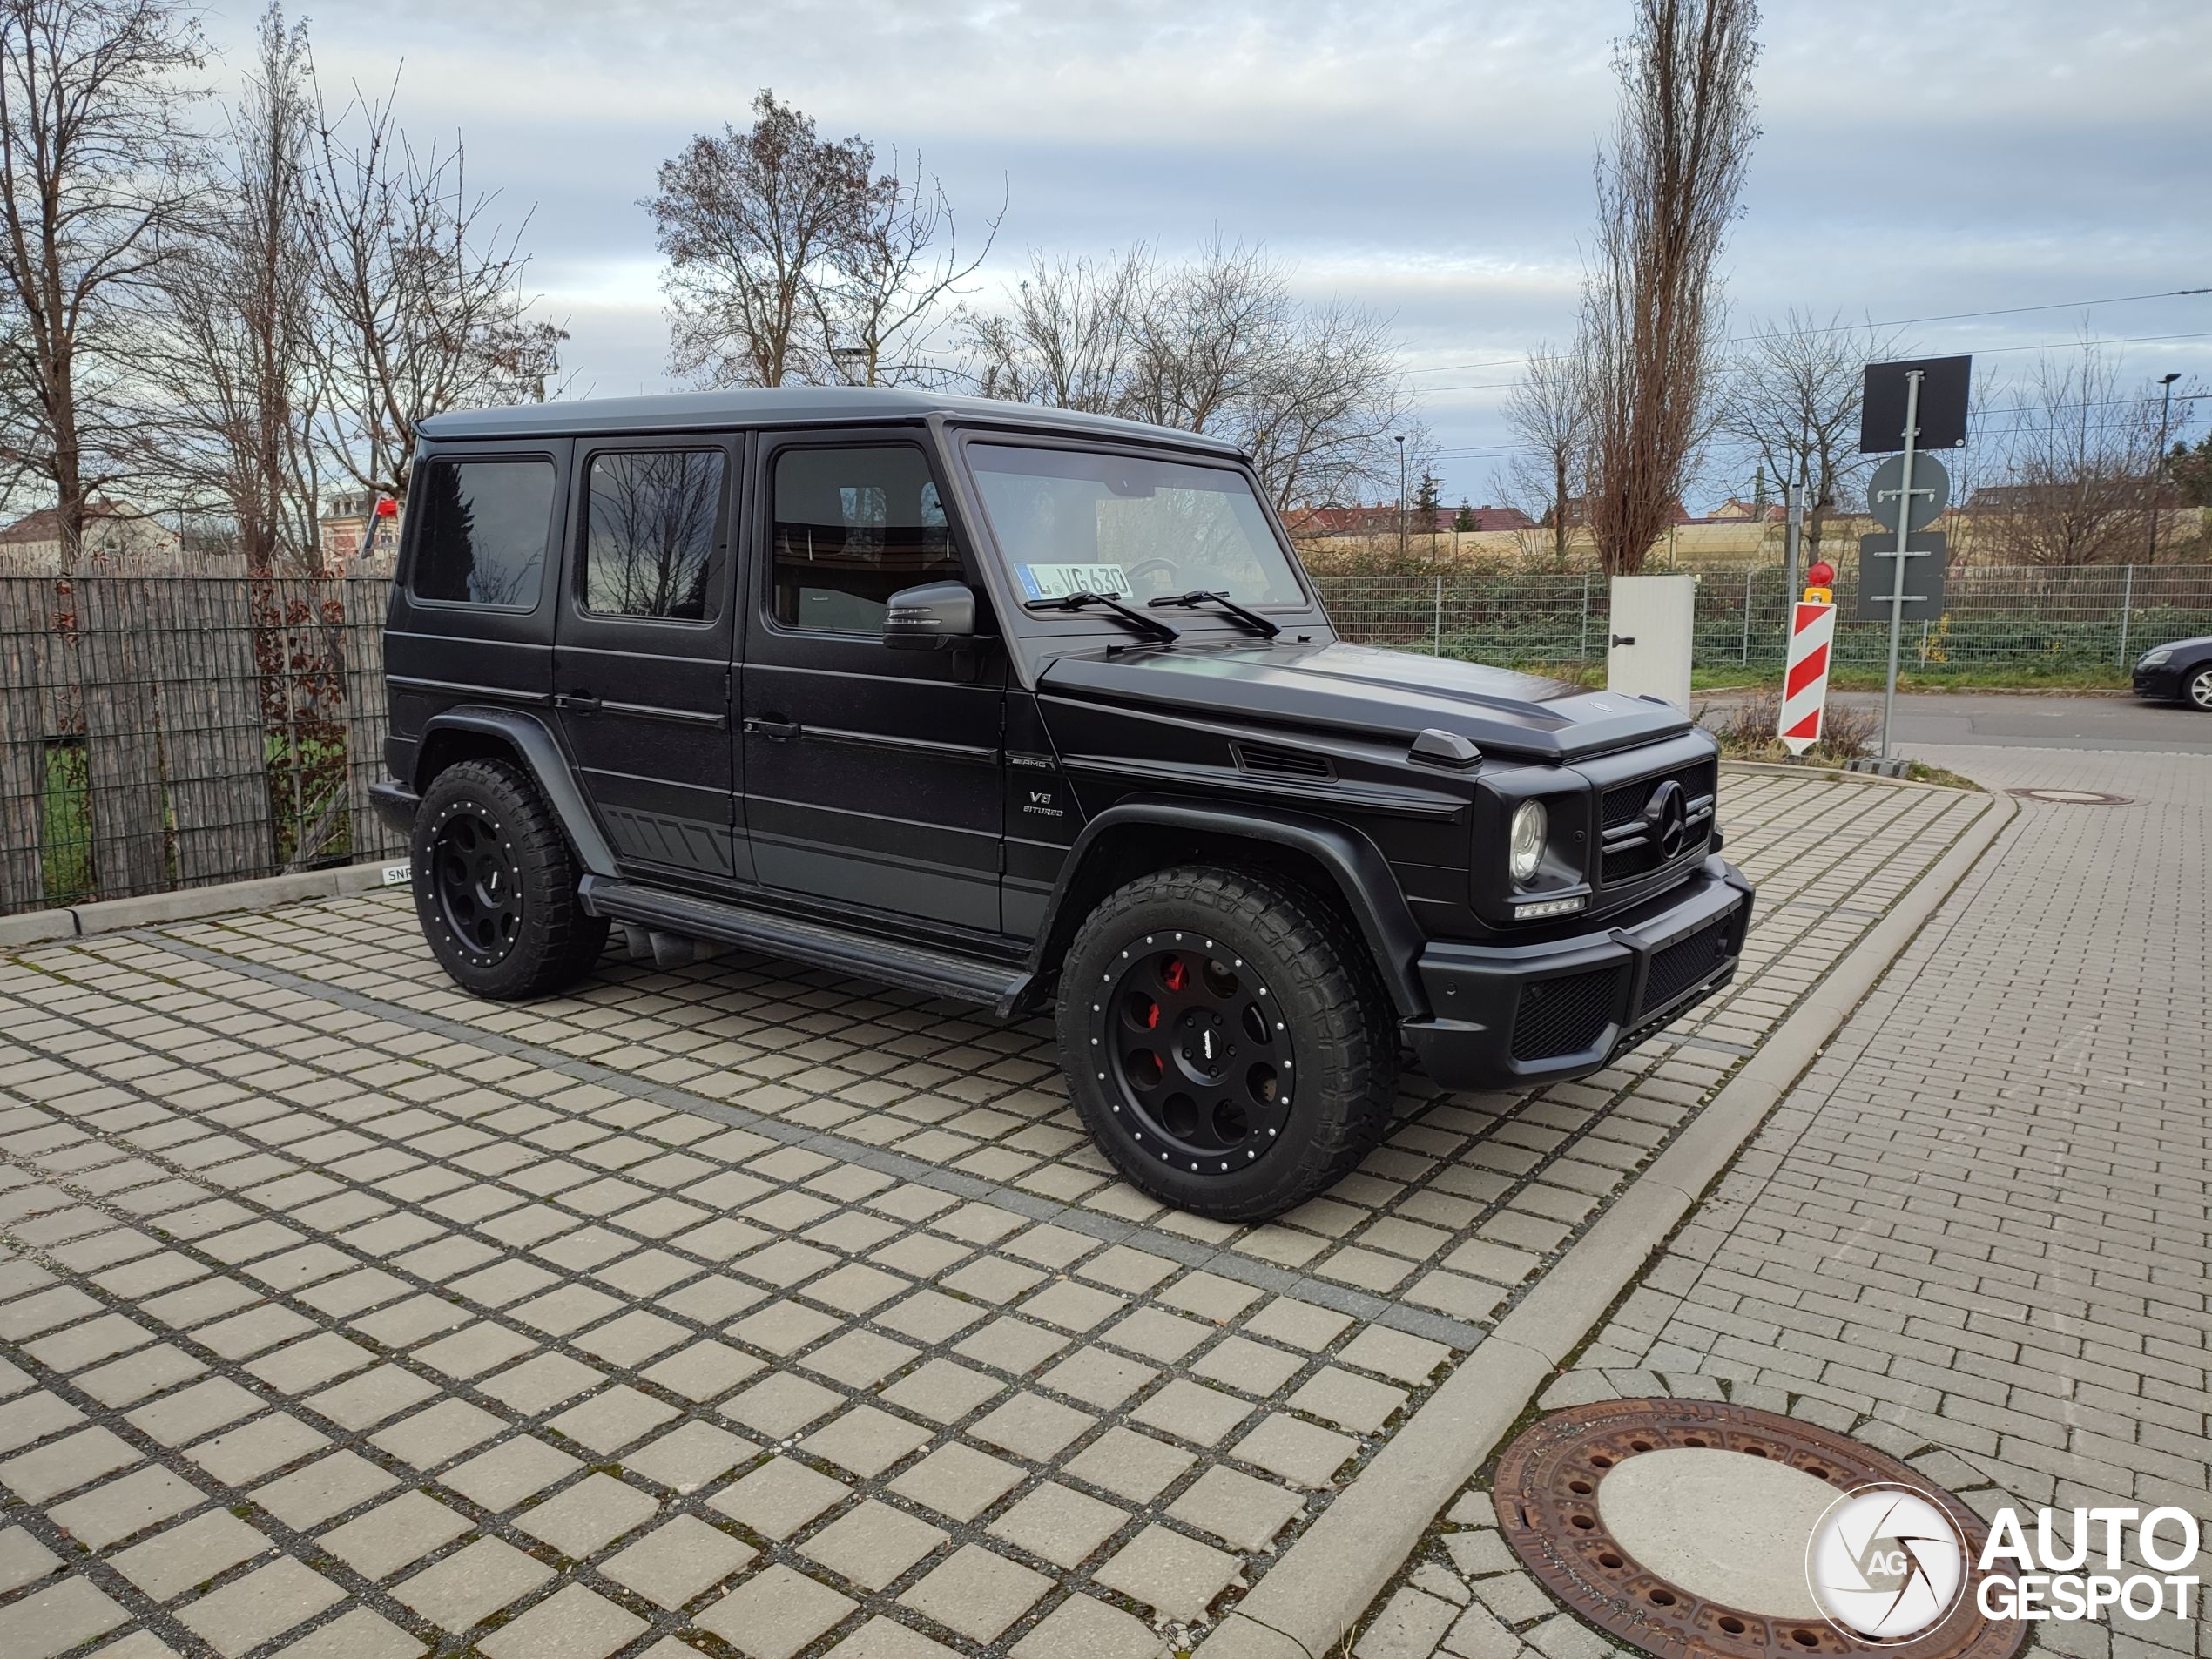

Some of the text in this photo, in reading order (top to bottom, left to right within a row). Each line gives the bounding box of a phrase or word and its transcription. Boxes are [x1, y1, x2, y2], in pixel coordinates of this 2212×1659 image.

[1030, 568, 1052, 594] L
[1030, 792, 1051, 805] V8
[1023, 806, 1063, 817] BITURBO
